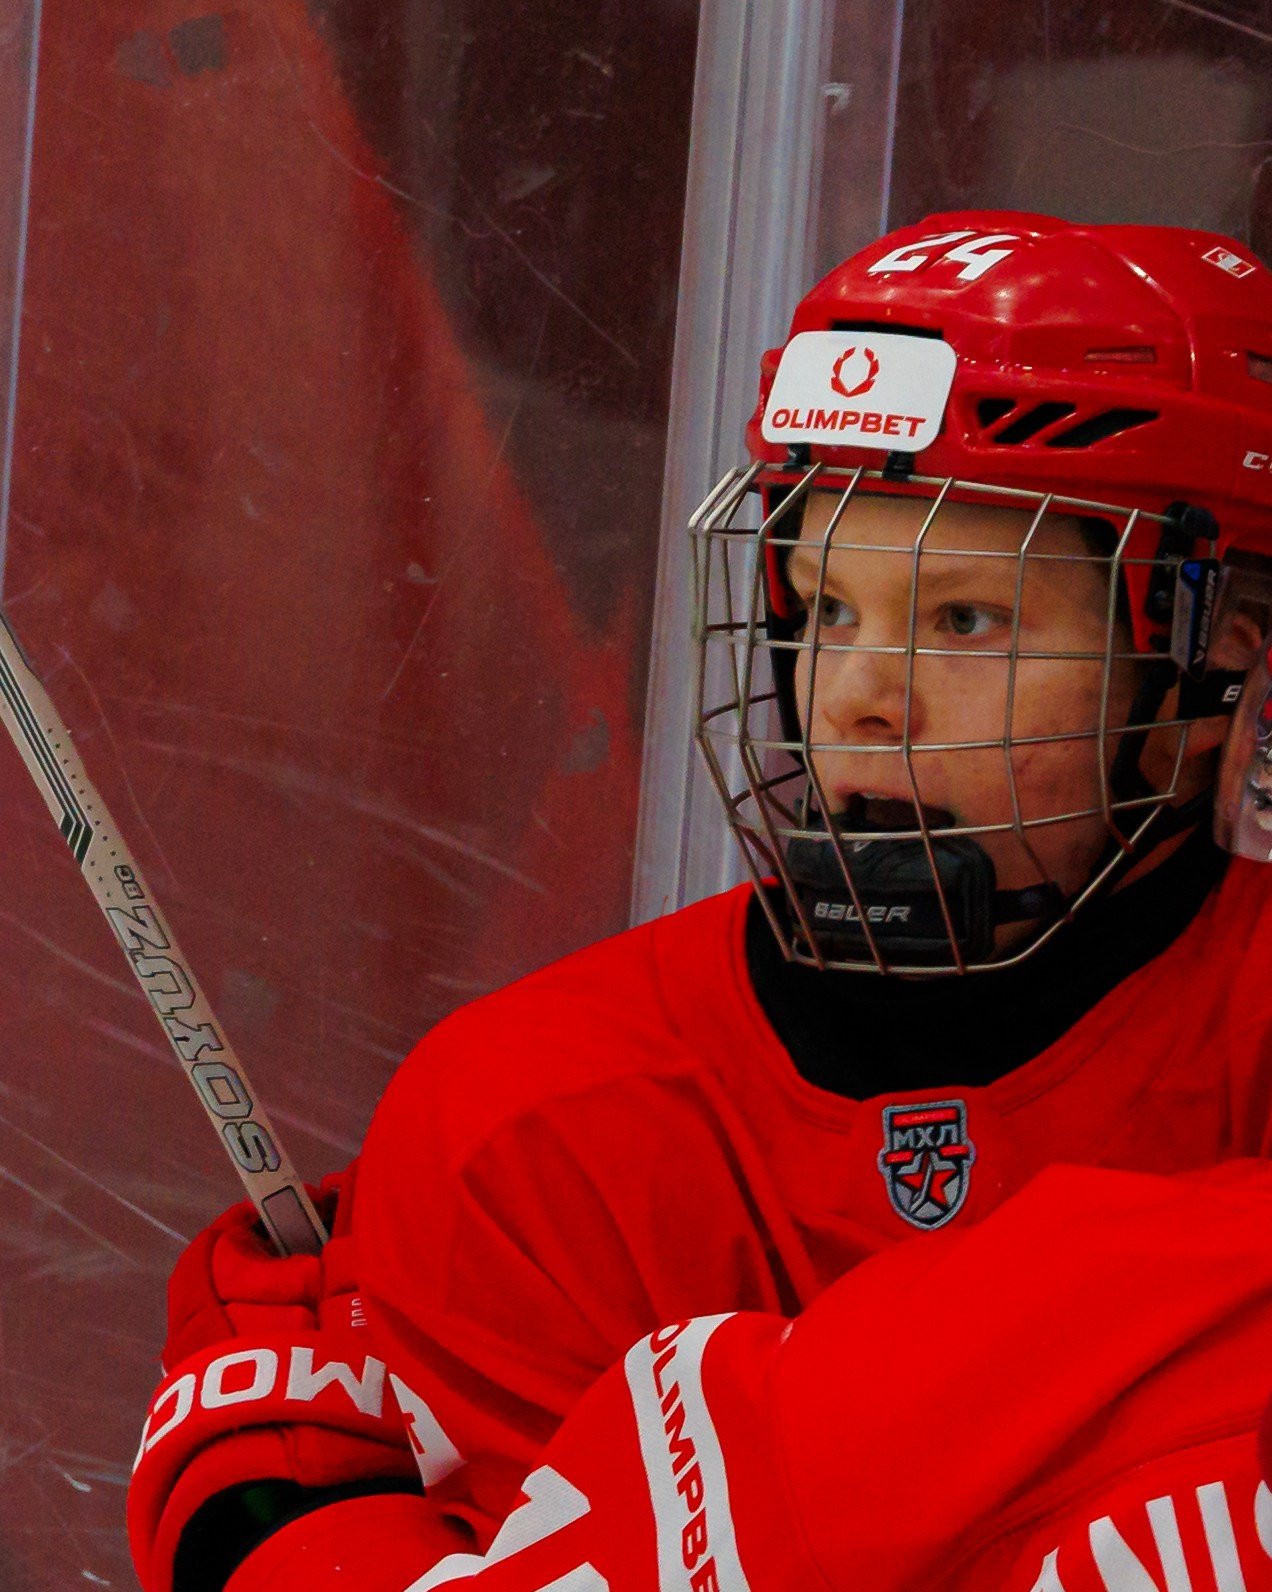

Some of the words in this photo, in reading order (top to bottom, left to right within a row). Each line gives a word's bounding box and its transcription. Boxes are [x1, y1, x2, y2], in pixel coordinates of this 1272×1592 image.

[867, 231, 1020, 281] 24
[771, 406, 926, 438] OLIMPBET
[814, 901, 911, 923] BAUER
[106, 904, 281, 1173] SOYUZ
[893, 1124, 959, 1150] МХЛ
